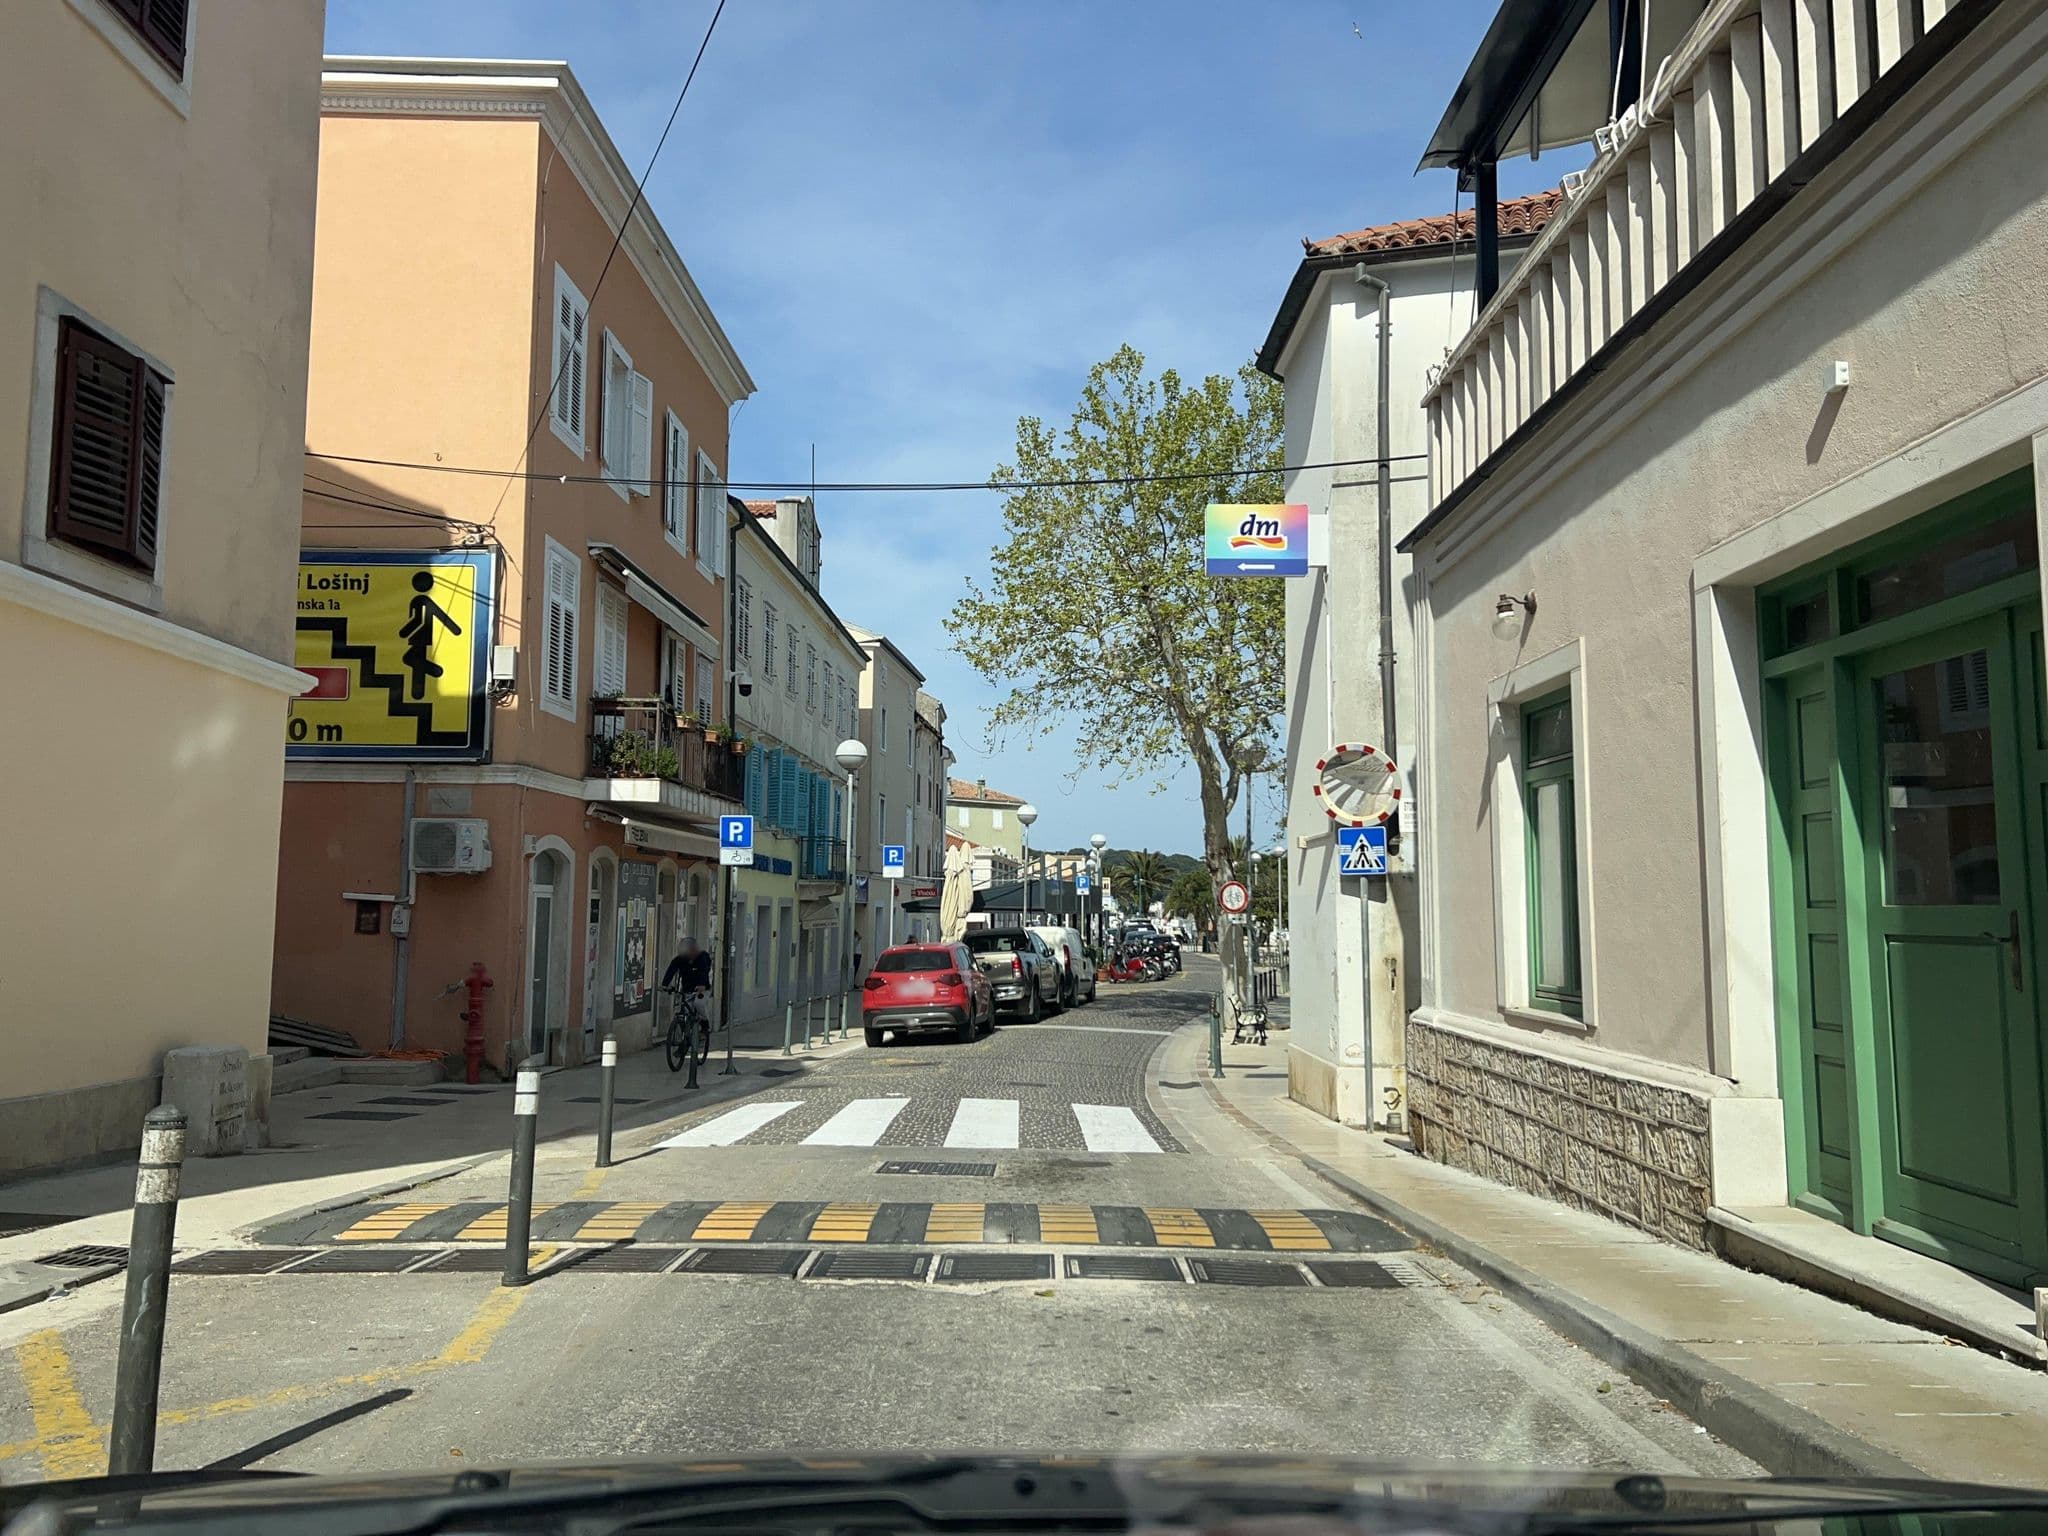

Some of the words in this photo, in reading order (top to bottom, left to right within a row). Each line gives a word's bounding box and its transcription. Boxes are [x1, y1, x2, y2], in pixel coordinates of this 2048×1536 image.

[1240, 514, 1279, 536] dm
[307, 573, 370, 595] Lošinj
[328, 599, 341, 610] 1a
[316, 725, 343, 741] m
[729, 822, 744, 842] P
[889, 850, 899, 863] P
[1079, 877, 1087, 887] P
